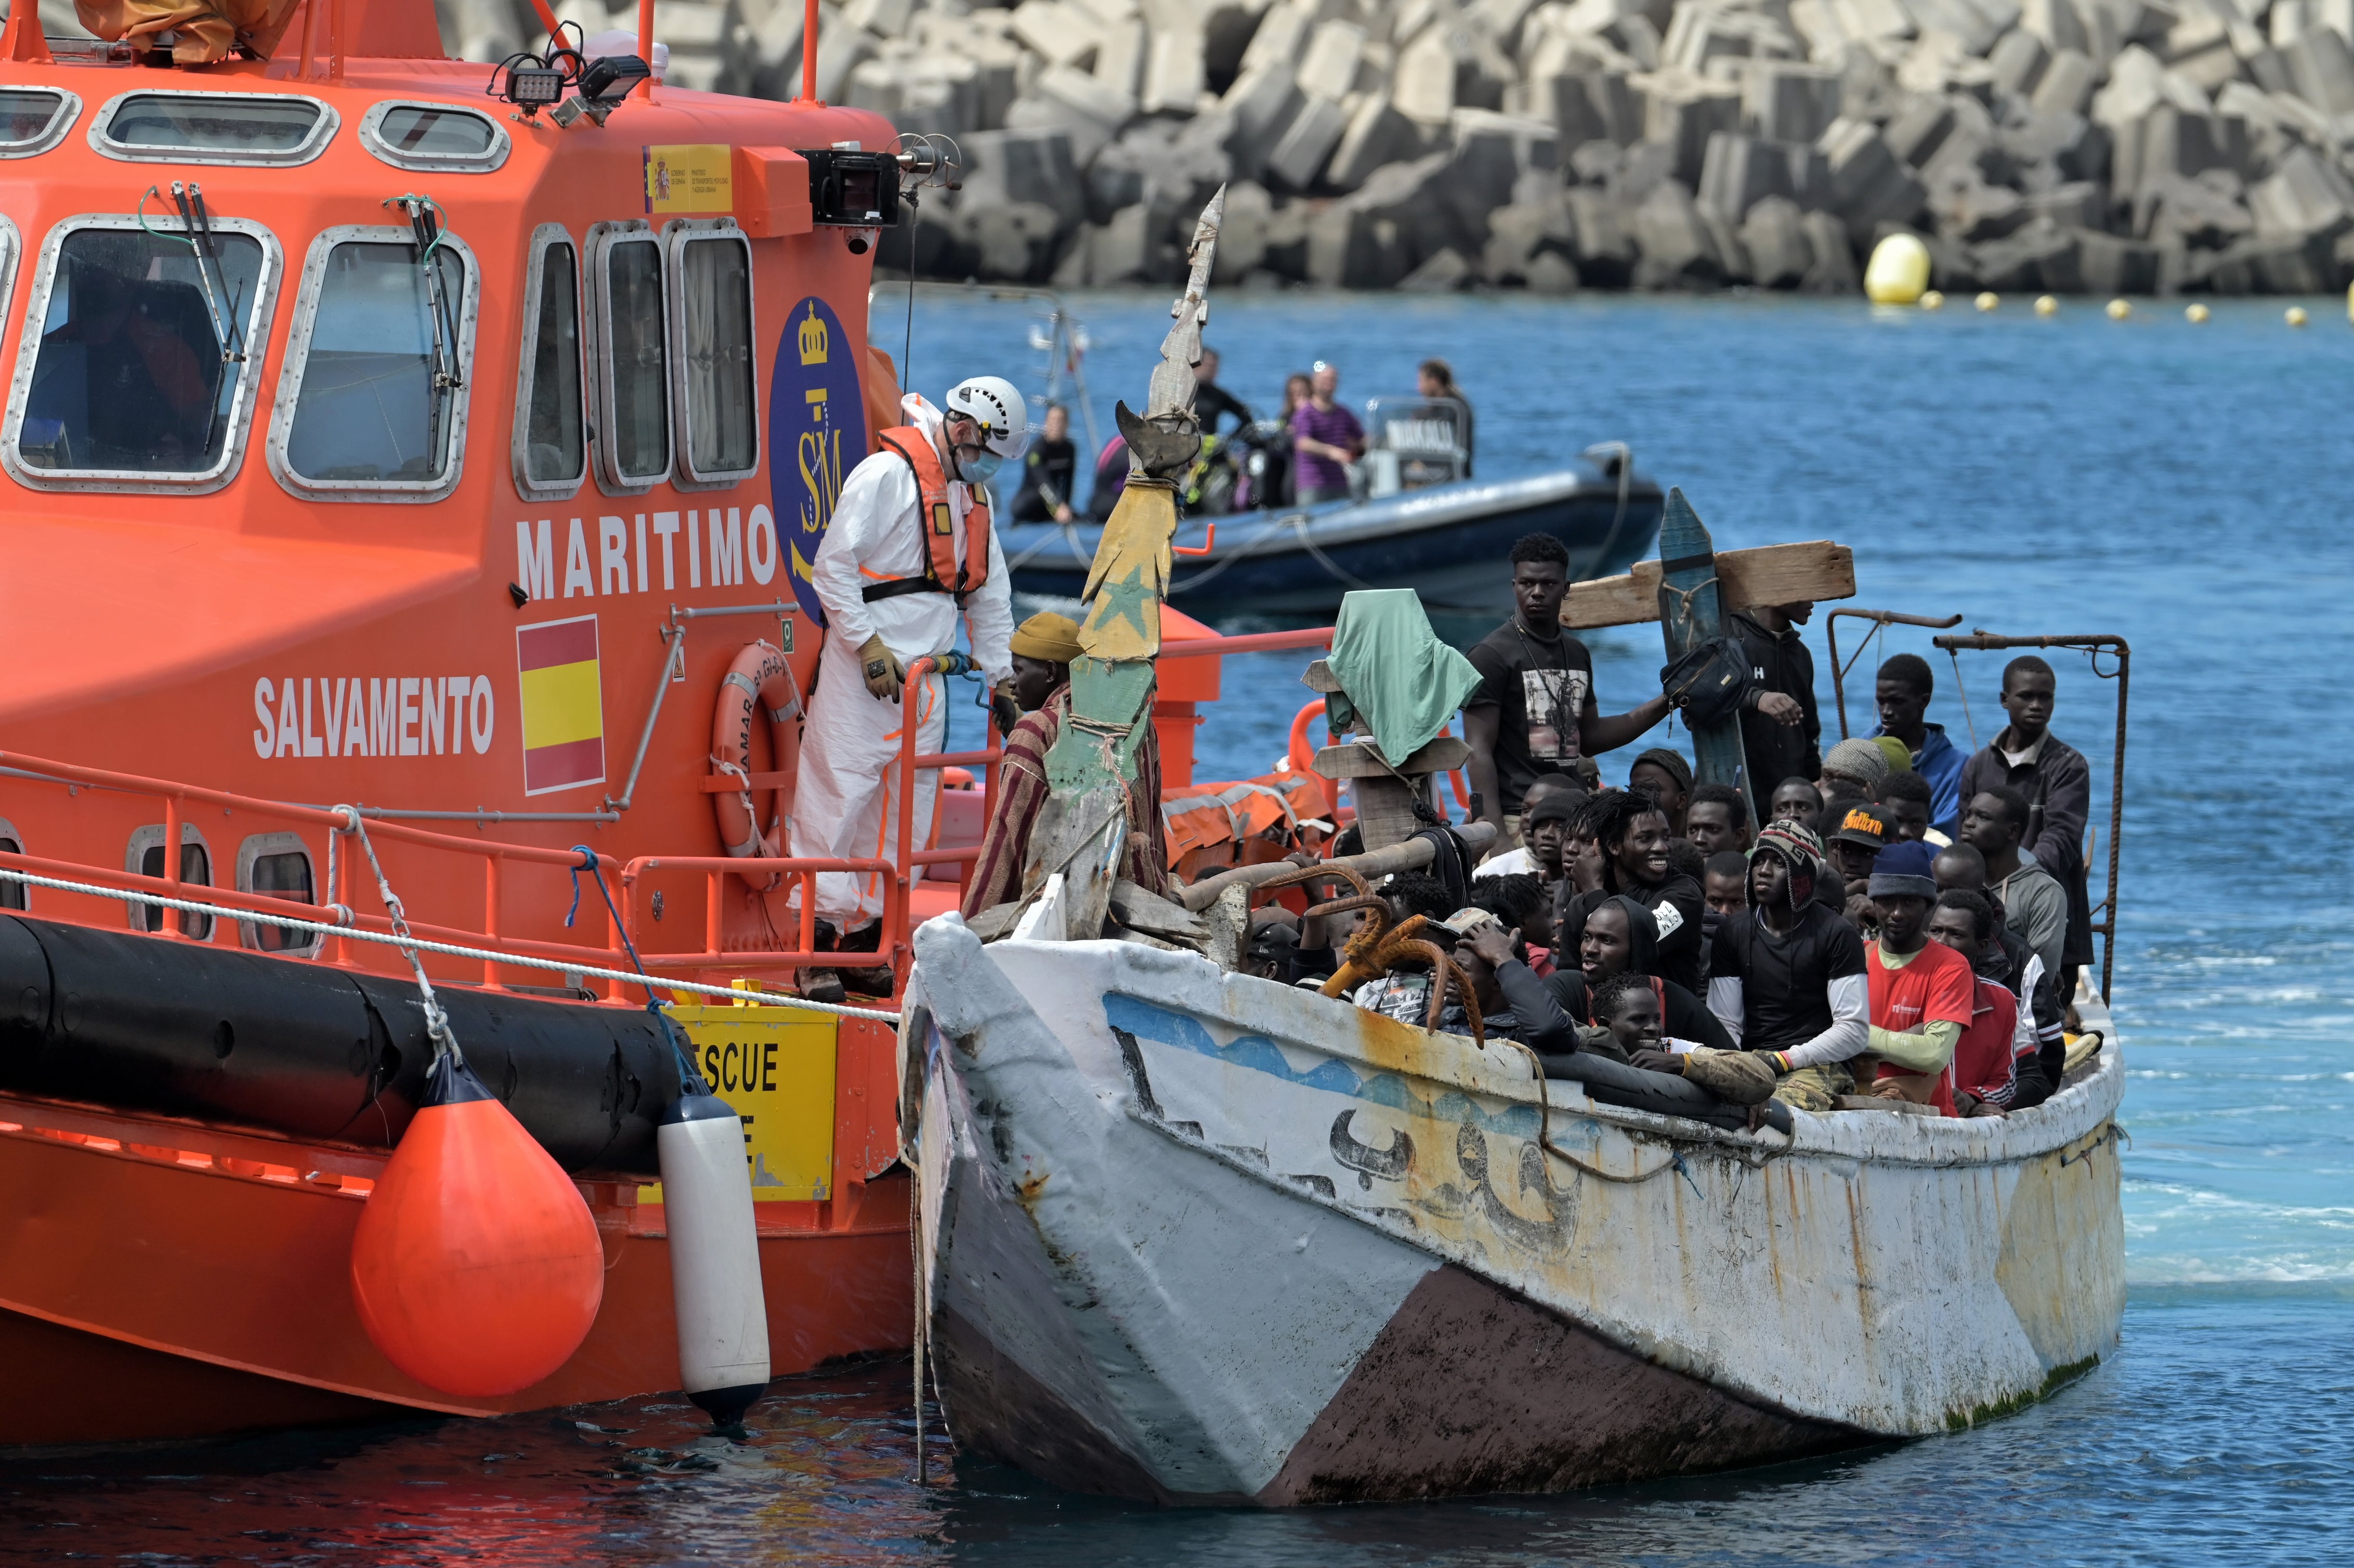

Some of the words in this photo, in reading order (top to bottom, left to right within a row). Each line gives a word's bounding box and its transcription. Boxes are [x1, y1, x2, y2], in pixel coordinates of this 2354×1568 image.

[799, 429, 841, 534] SM
[516, 504, 776, 601] MARITIMO
[1754, 667, 1764, 680] H
[253, 675, 494, 759] SALVAMENTO
[1662, 915, 1679, 932] CTM
[692, 1042, 778, 1094] SCUE
